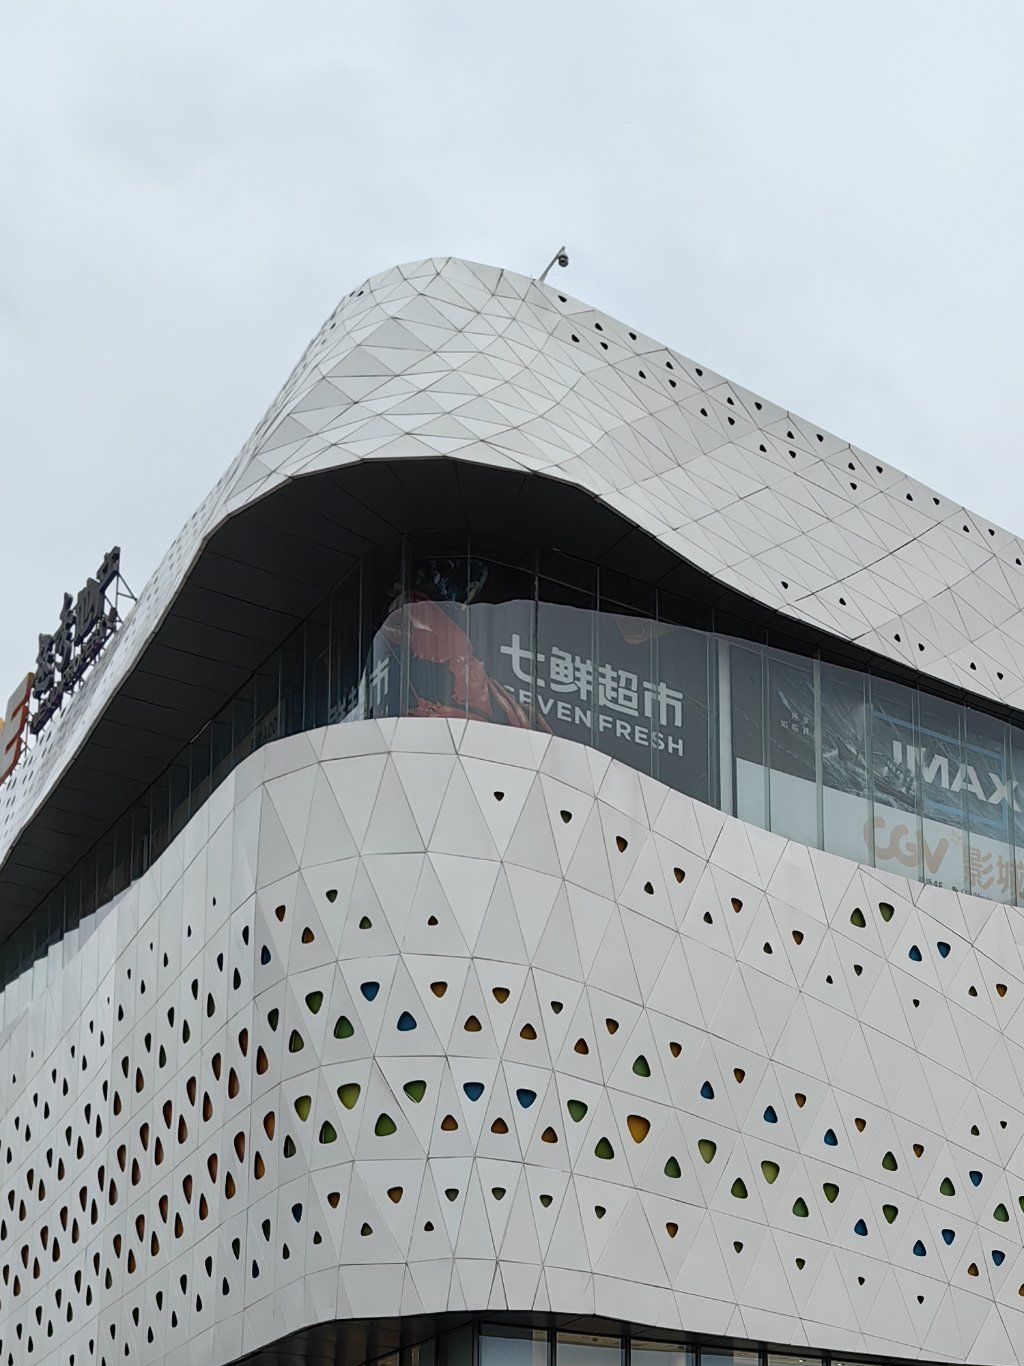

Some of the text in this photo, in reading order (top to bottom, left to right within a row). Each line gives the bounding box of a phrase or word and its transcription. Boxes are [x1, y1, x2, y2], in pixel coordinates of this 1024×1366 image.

[500, 633, 683, 727] 七鲜超市
[599, 714, 684, 757] FRESH
[892, 740, 1021, 812] IMAX
[863, 816, 949, 874] CGV
